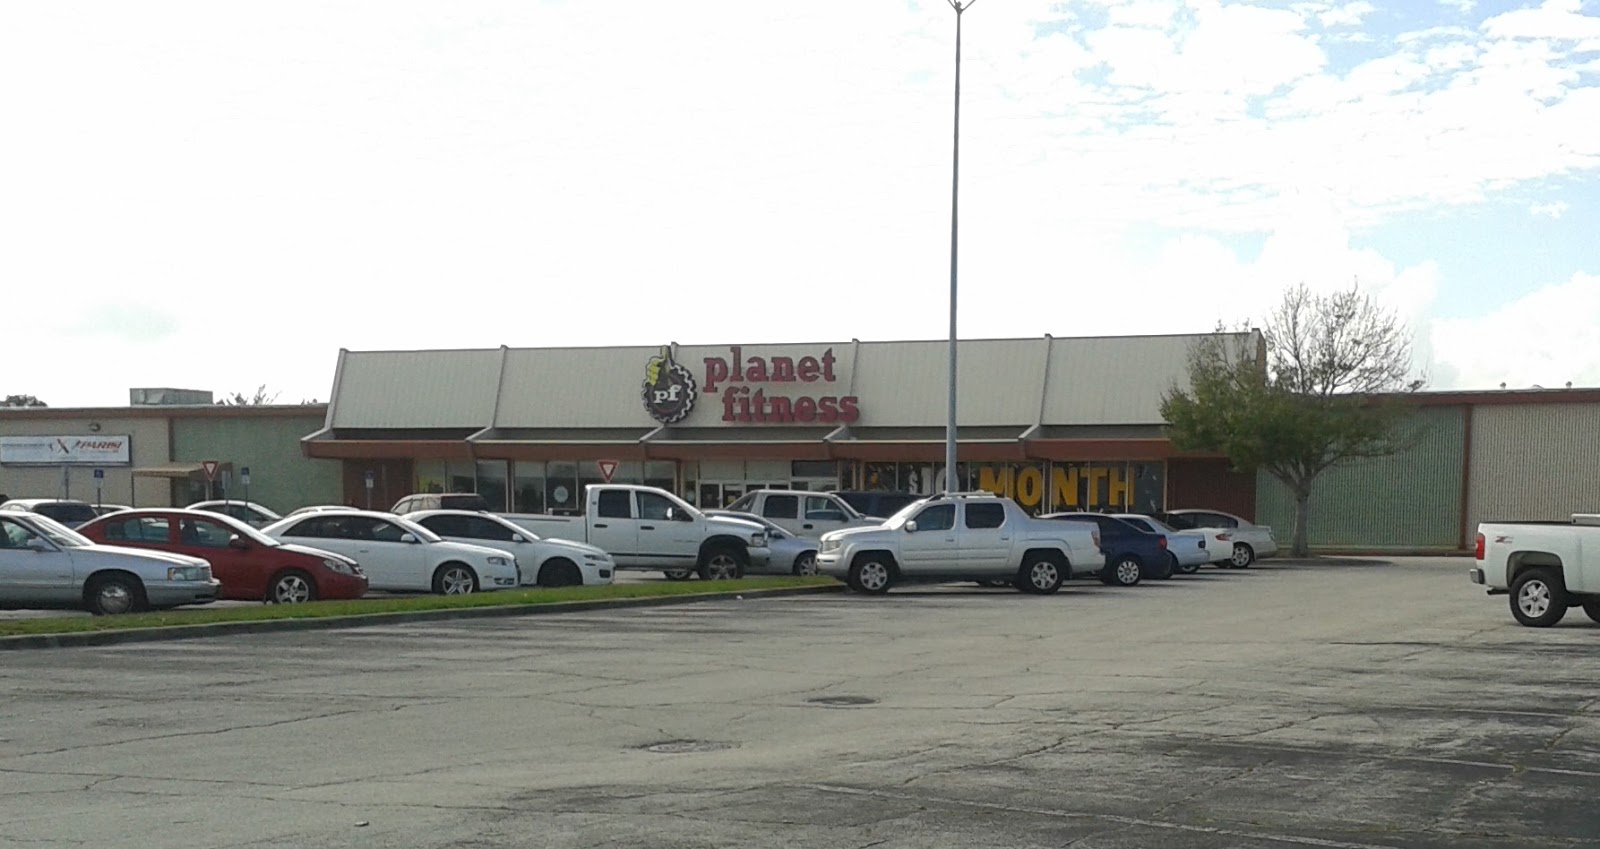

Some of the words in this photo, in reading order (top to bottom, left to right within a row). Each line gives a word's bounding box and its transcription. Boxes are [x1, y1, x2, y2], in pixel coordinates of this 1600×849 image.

[703, 347, 836, 393] planet
[653, 384, 682, 403] pf
[721, 386, 860, 422] fitness
[980, 466, 1135, 506] MONTH
